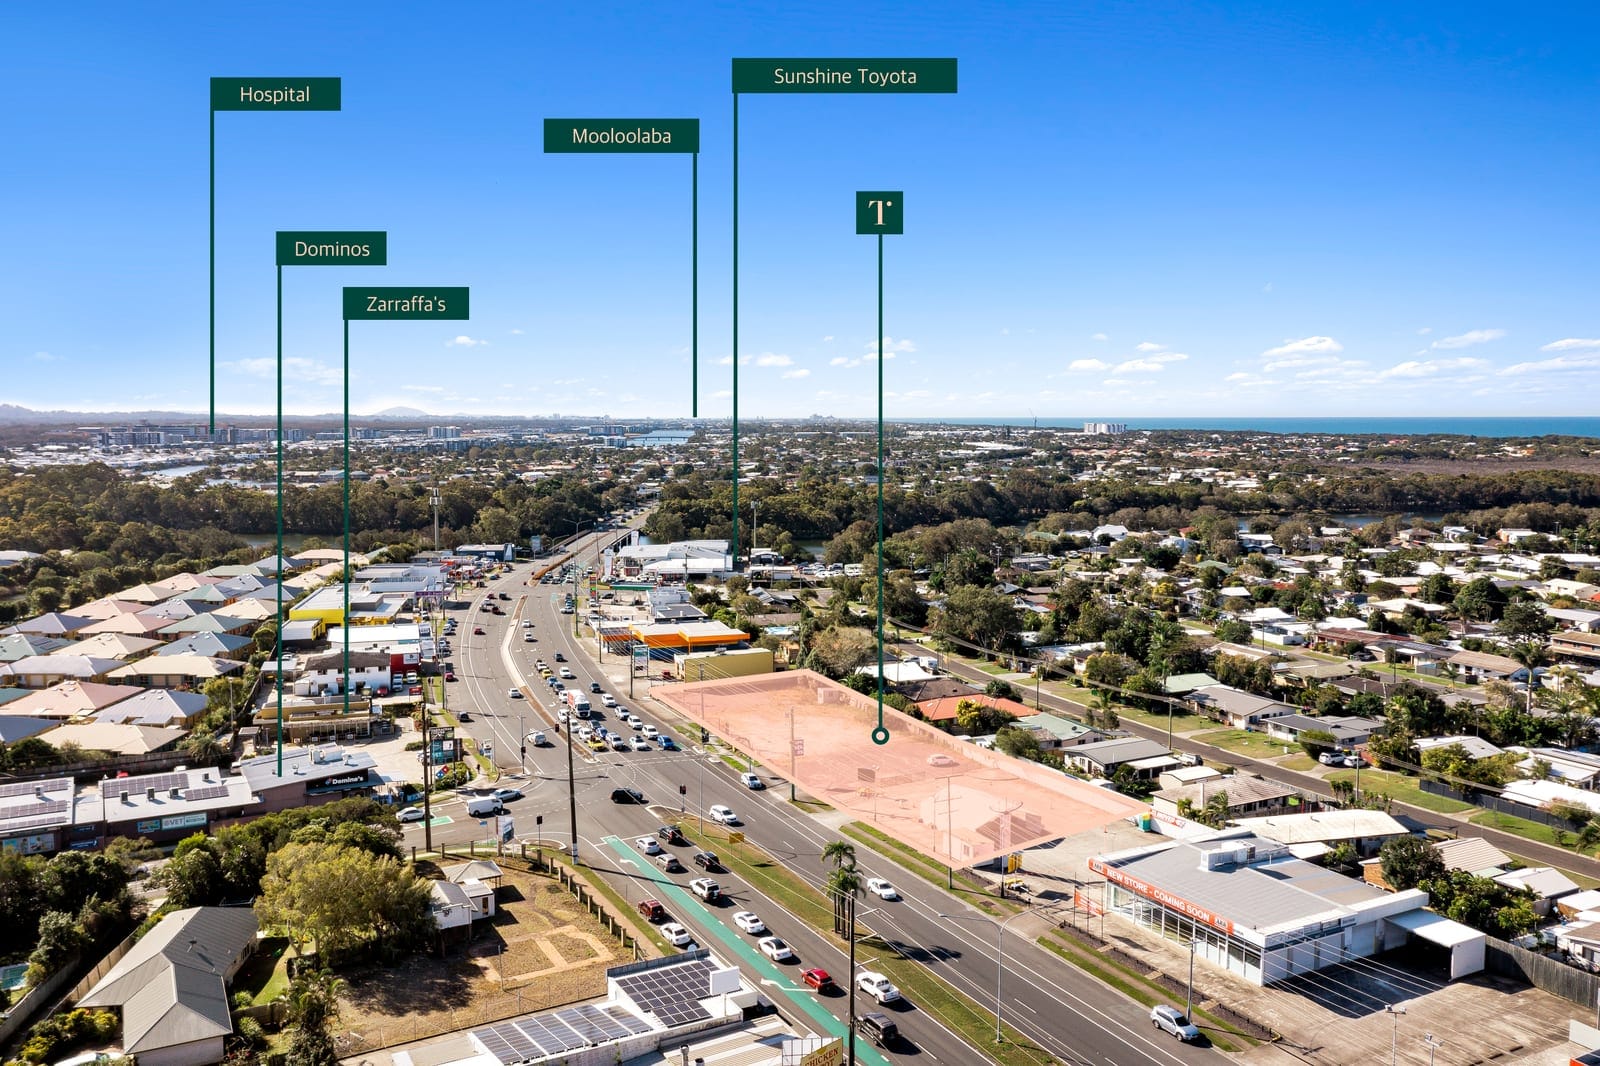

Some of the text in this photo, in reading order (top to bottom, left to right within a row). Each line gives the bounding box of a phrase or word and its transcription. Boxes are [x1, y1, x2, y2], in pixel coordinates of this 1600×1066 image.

[332, 775, 364, 785] Domino's
[1106, 867, 1124, 883] NEW
[1124, 875, 1148, 893] STORE
[1153, 889, 1186, 911] COMING
[1186, 904, 1210, 923] SOON
